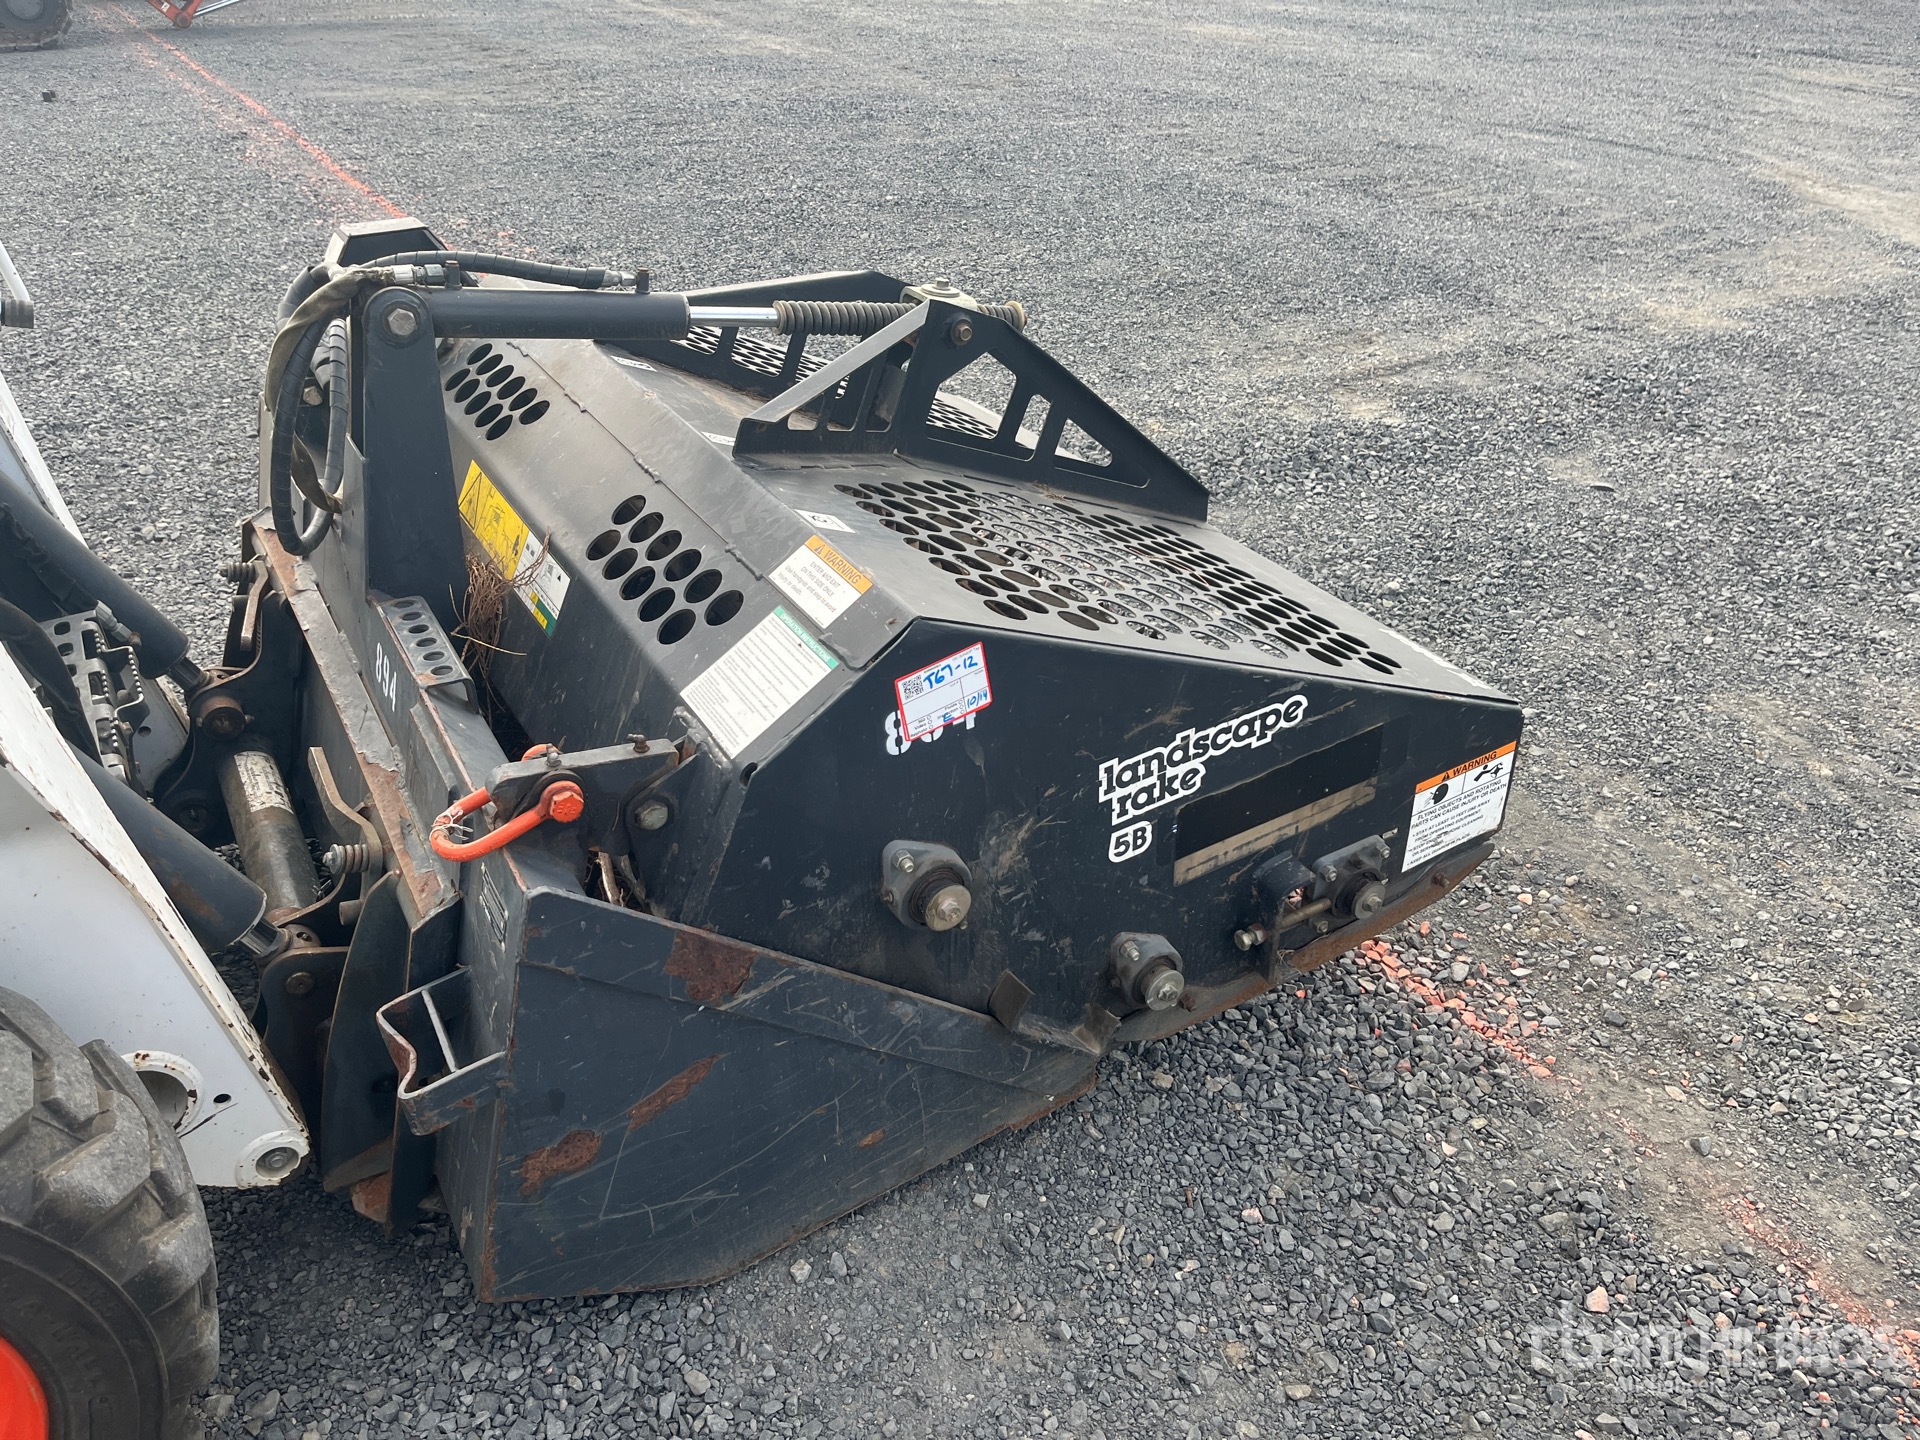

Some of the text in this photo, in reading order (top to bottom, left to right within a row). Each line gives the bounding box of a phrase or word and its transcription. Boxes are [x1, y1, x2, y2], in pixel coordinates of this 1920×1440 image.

[809, 561, 824, 574] ENTER
[829, 578, 840, 588] EXIT
[821, 549, 862, 584] WARNING
[376, 642, 397, 712] 894
[1101, 697, 1306, 800] landscape
[1452, 750, 1497, 776] WARNING
[1114, 765, 1203, 821] rake
[1411, 817, 1428, 830] PARTS
[1429, 812, 1441, 821] CAN
[1441, 803, 1459, 816] CAUSE
[1461, 794, 1479, 807] INJURY
[1480, 790, 1488, 798] OR
[1489, 782, 1506, 794] DEATH
[1417, 807, 1437, 821] FLYING
[1437, 796, 1462, 811] OBJECTS
[1463, 790, 1474, 800] AND
[1475, 778, 1501, 794] ROTATING
[1112, 825, 1149, 858] 5B
